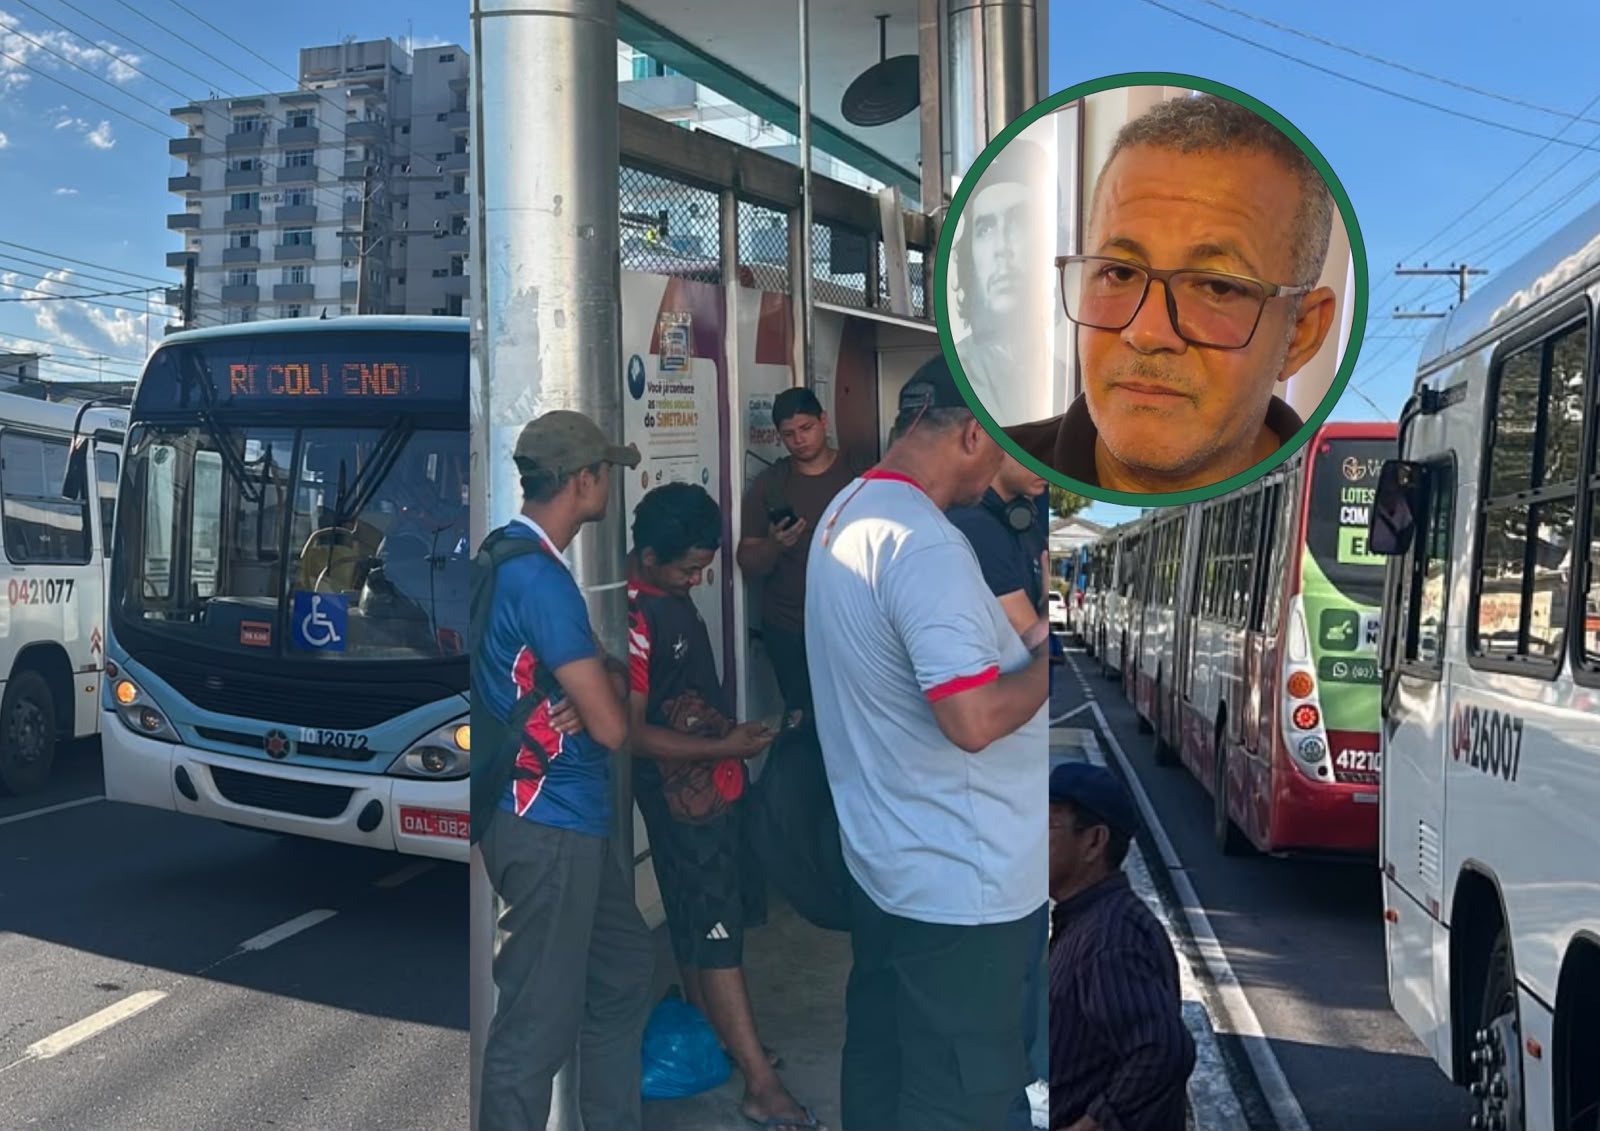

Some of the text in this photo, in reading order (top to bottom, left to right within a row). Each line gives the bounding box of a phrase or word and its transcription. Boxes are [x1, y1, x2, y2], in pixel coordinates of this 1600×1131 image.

[647, 381, 661, 393] Você
[669, 381, 695, 394] conhece
[648, 399, 655, 409] as
[644, 412, 655, 428] do
[750, 426, 782, 447] Recarg
[1342, 487, 1376, 505] LOTES
[1341, 506, 1368, 525] COM
[8, 578, 75, 605] 0421077
[1452, 701, 1524, 782] 0426007
[404, 816, 471, 837] OAL-082
